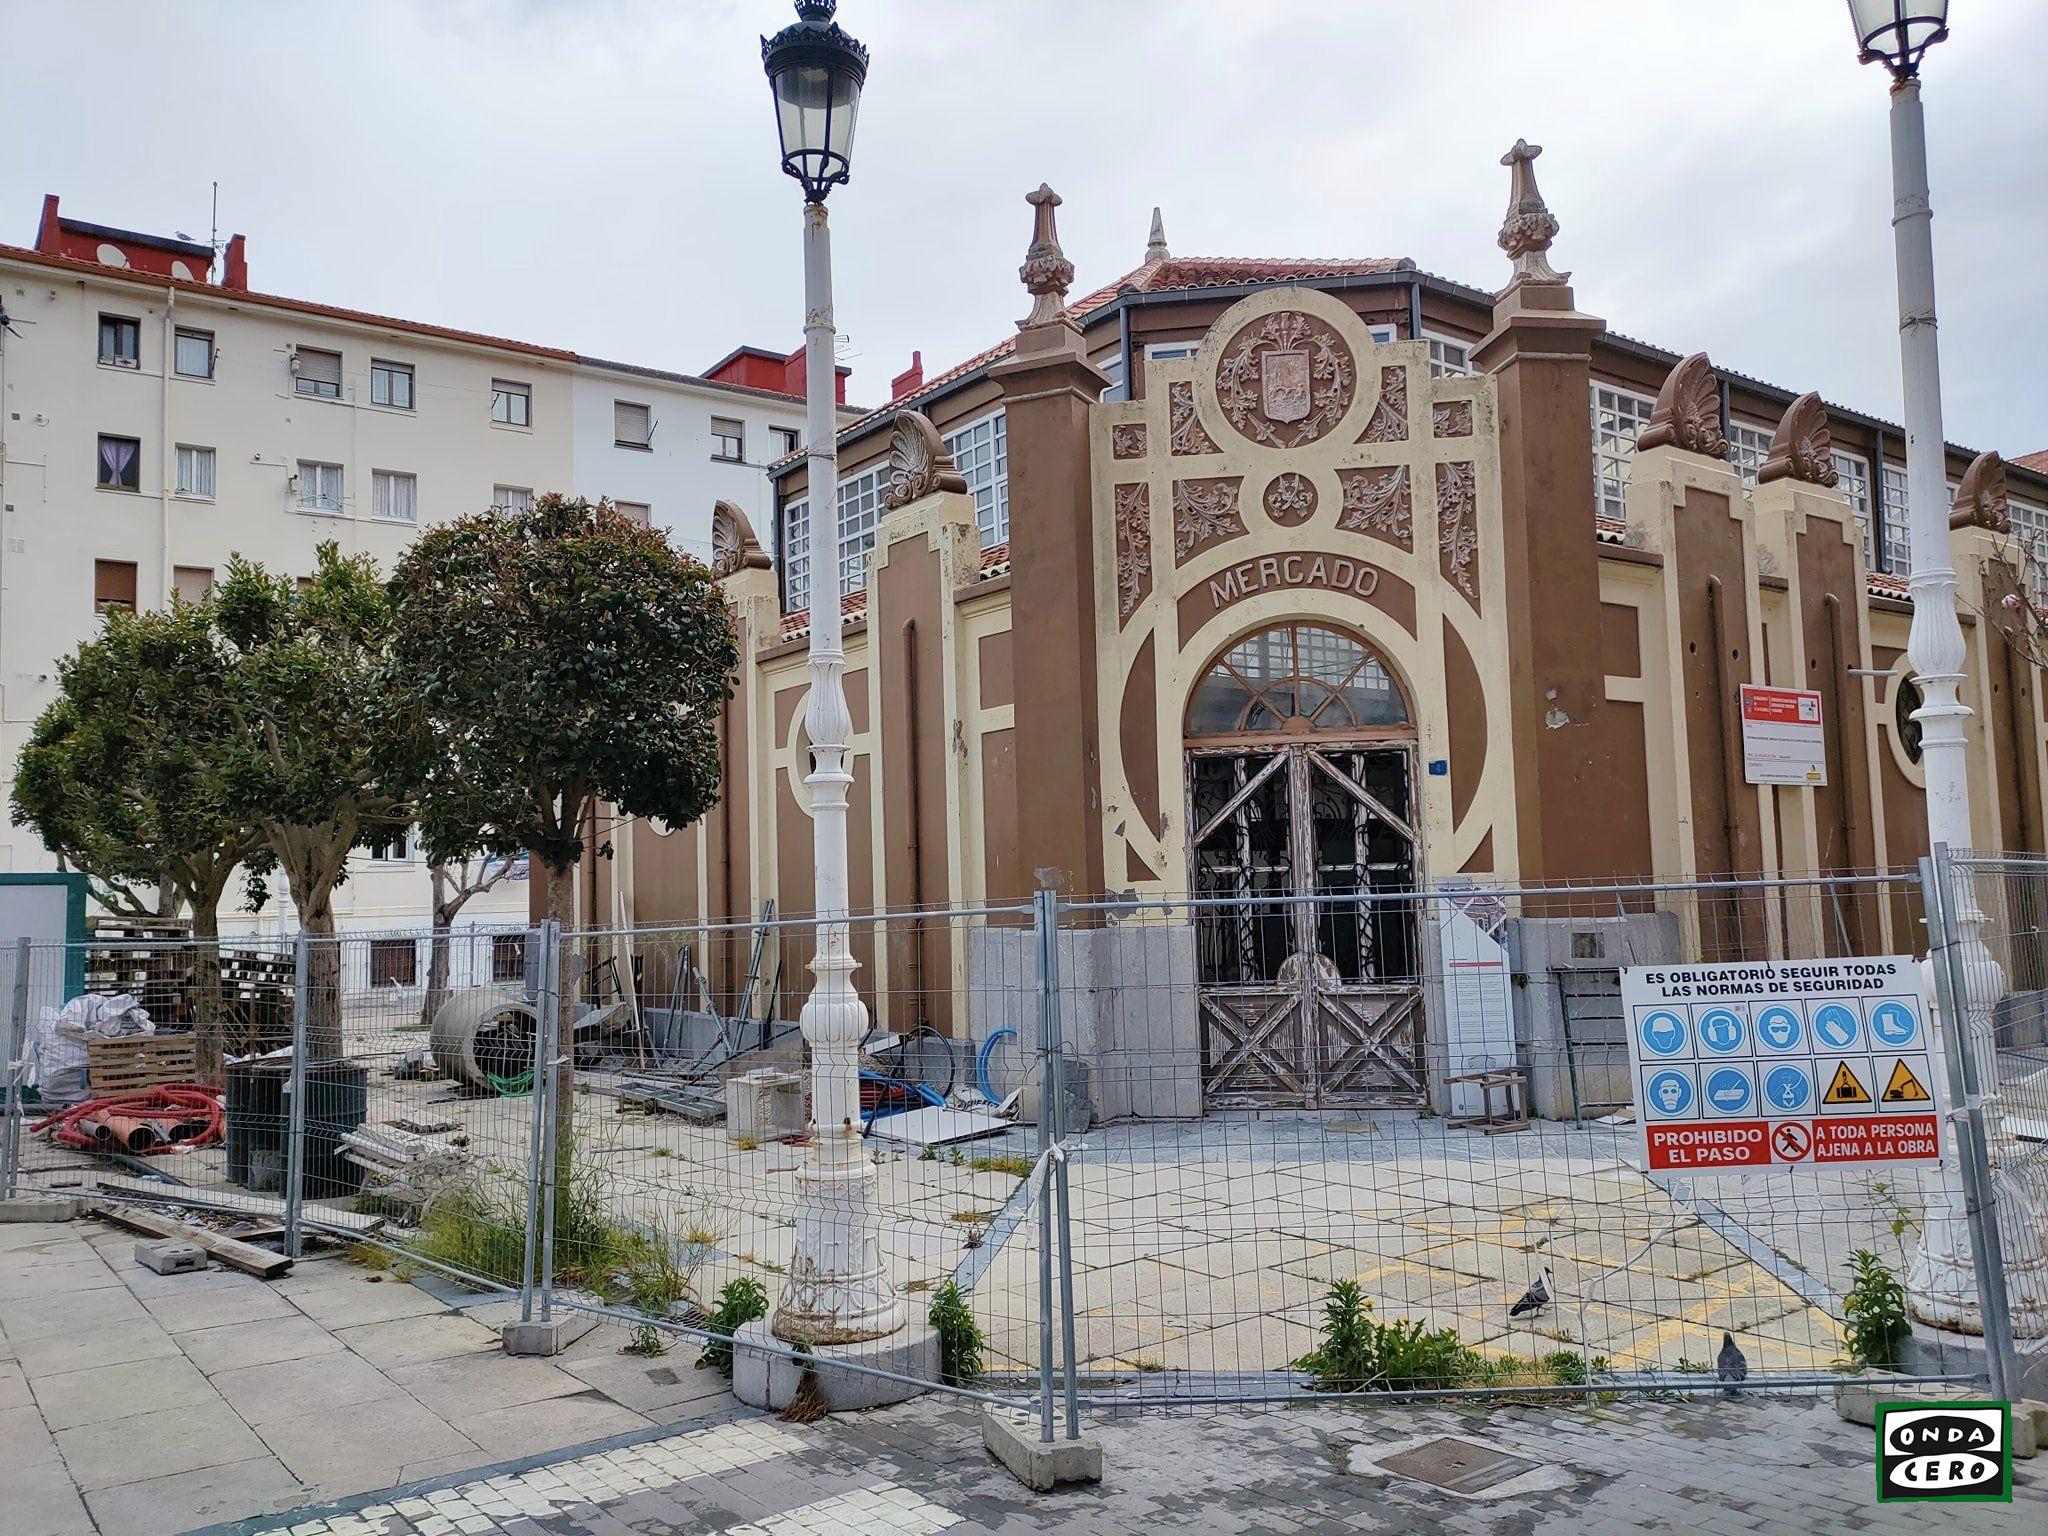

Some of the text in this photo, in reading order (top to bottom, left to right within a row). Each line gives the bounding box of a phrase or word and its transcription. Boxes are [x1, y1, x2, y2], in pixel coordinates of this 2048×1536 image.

[1209, 555, 1379, 609] MERCADO
[1645, 964, 1896, 984] ES OBLIGATORIO SEGUIR TODAS
[1662, 978, 1884, 997] LAS NORMAS DE SEGURIDAD
[1653, 1128, 1763, 1147] PROHIBIDO
[1816, 1122, 1935, 1140] A TODA PERSONA
[1668, 1146, 1750, 1163] EL PASO
[1817, 1139, 1936, 1157] AJENA A LA OBRA
